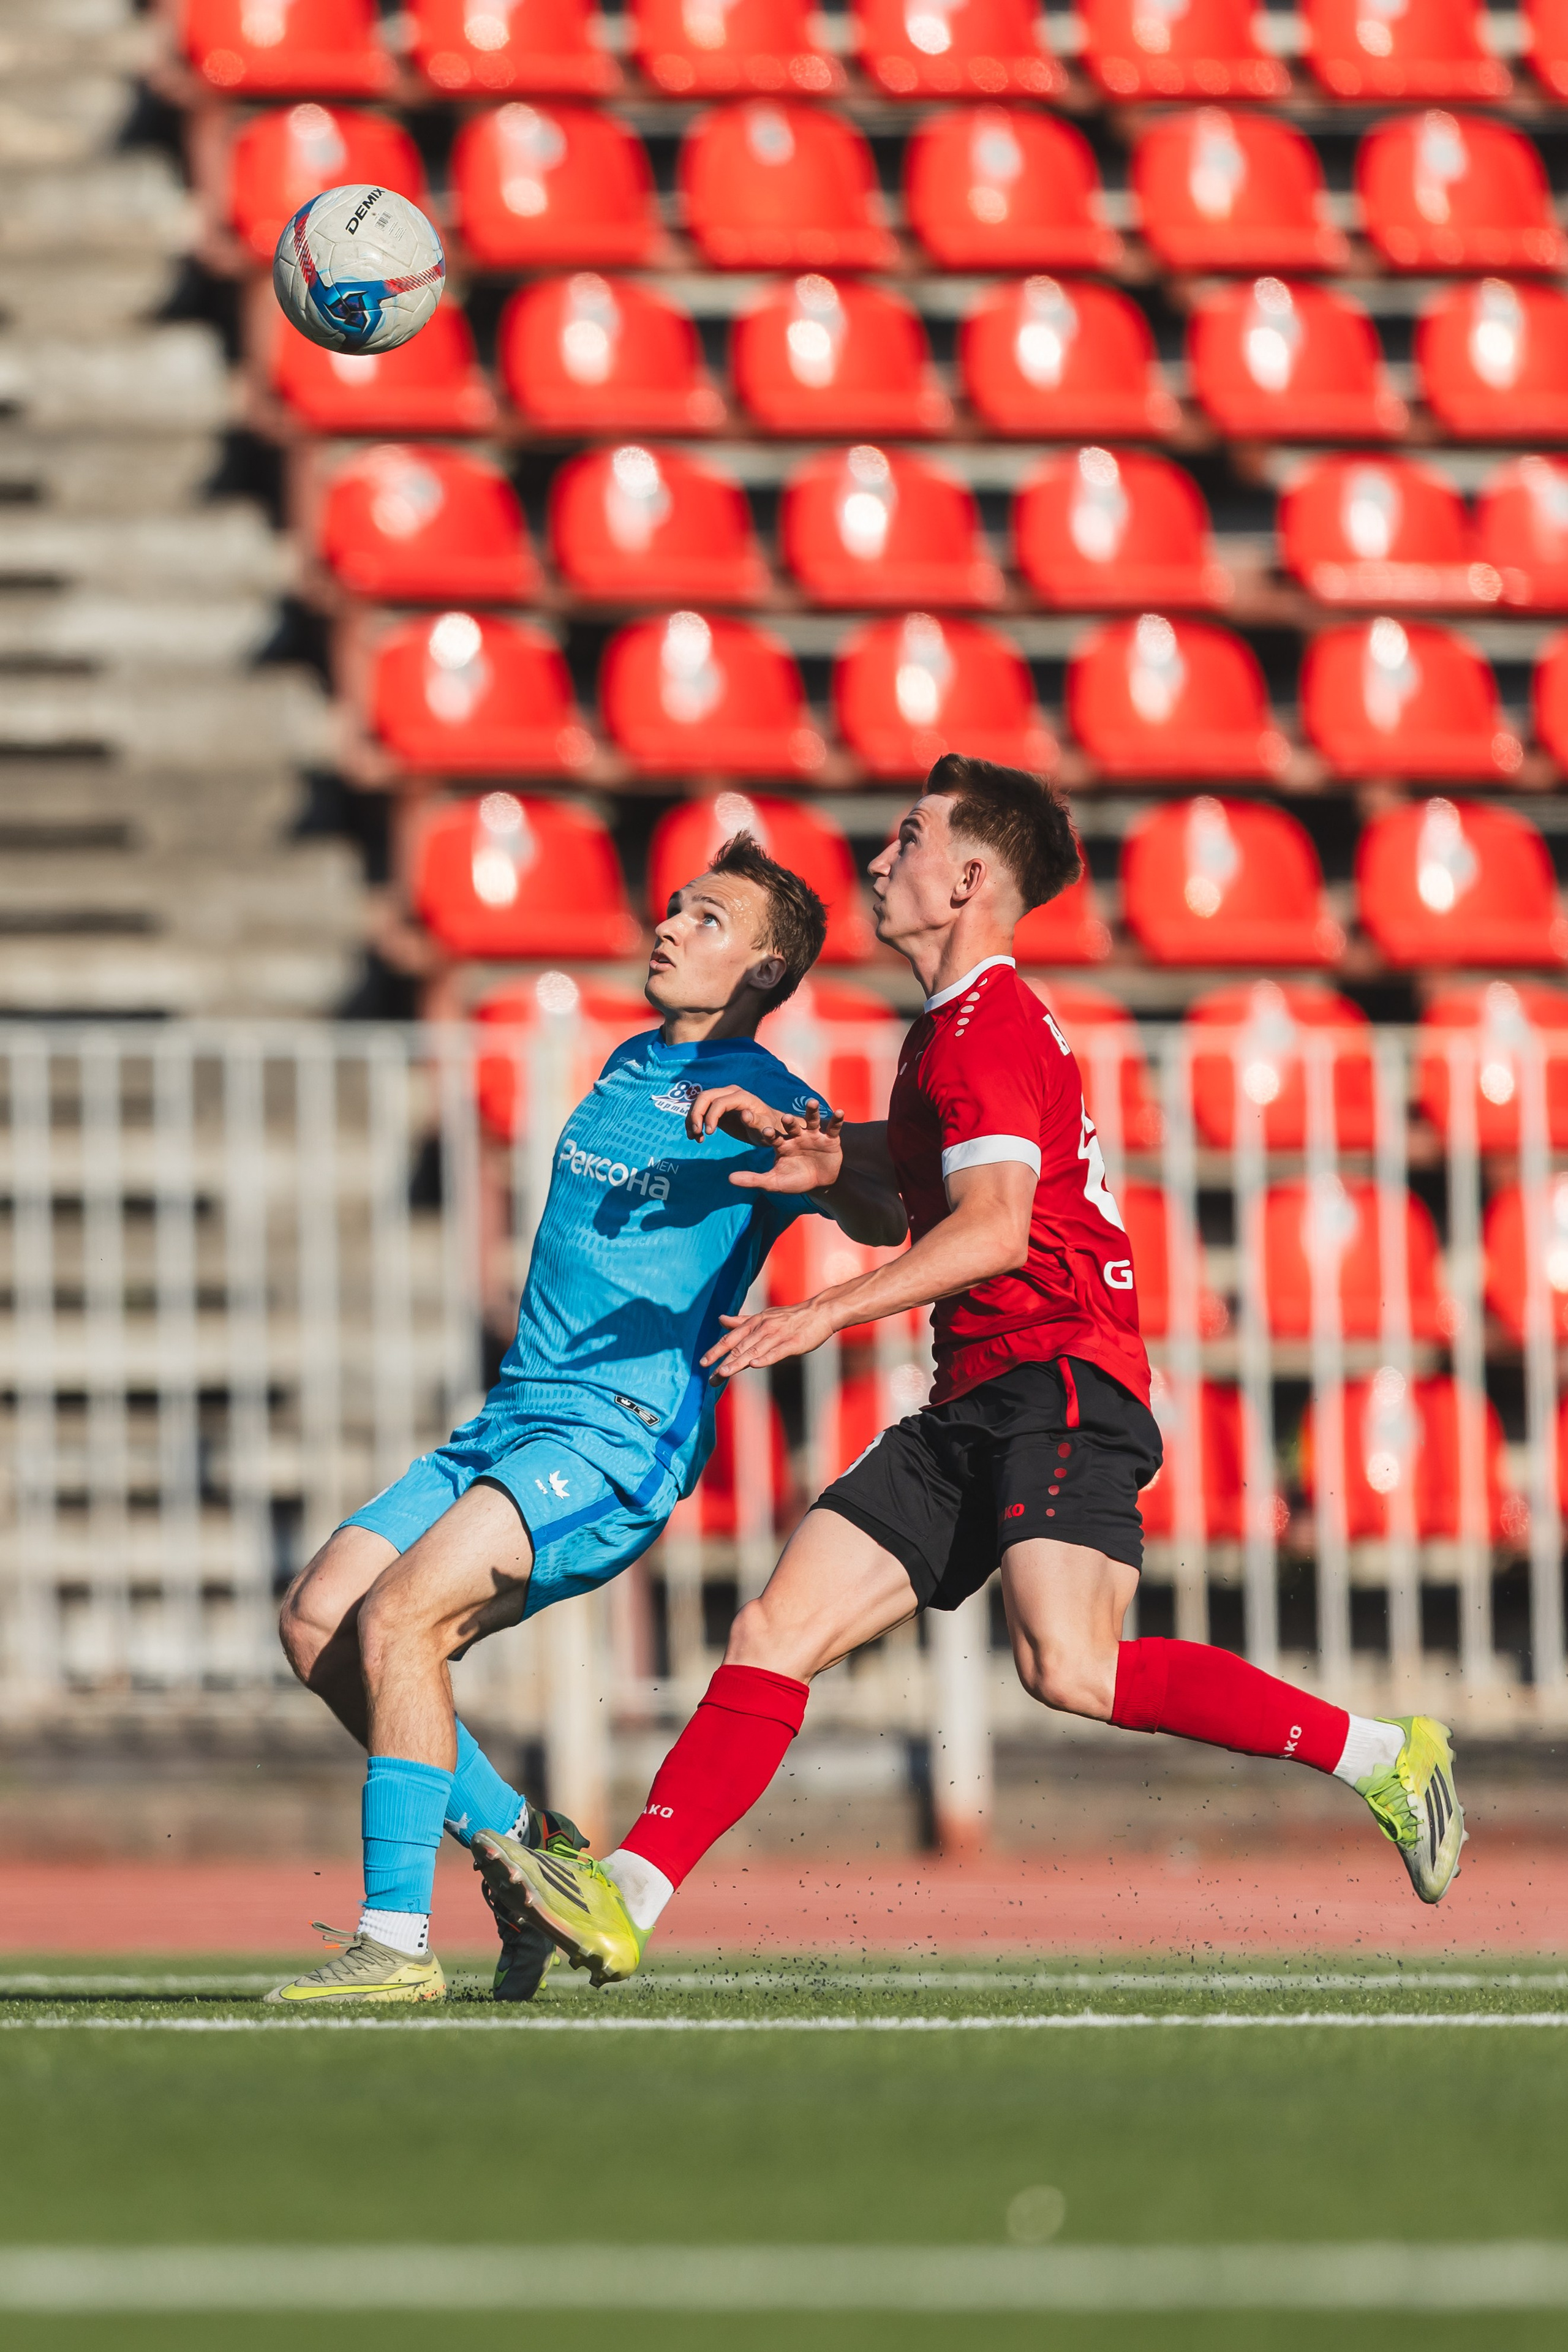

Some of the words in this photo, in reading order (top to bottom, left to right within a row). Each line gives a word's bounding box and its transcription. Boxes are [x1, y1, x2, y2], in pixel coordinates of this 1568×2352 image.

[345, 187, 386, 235] DEMIX
[557, 1139, 670, 1200] Рексона
[648, 1156, 679, 1174] MEN
[1103, 1259, 1133, 1290] G
[1280, 1725, 1303, 1758] KO
